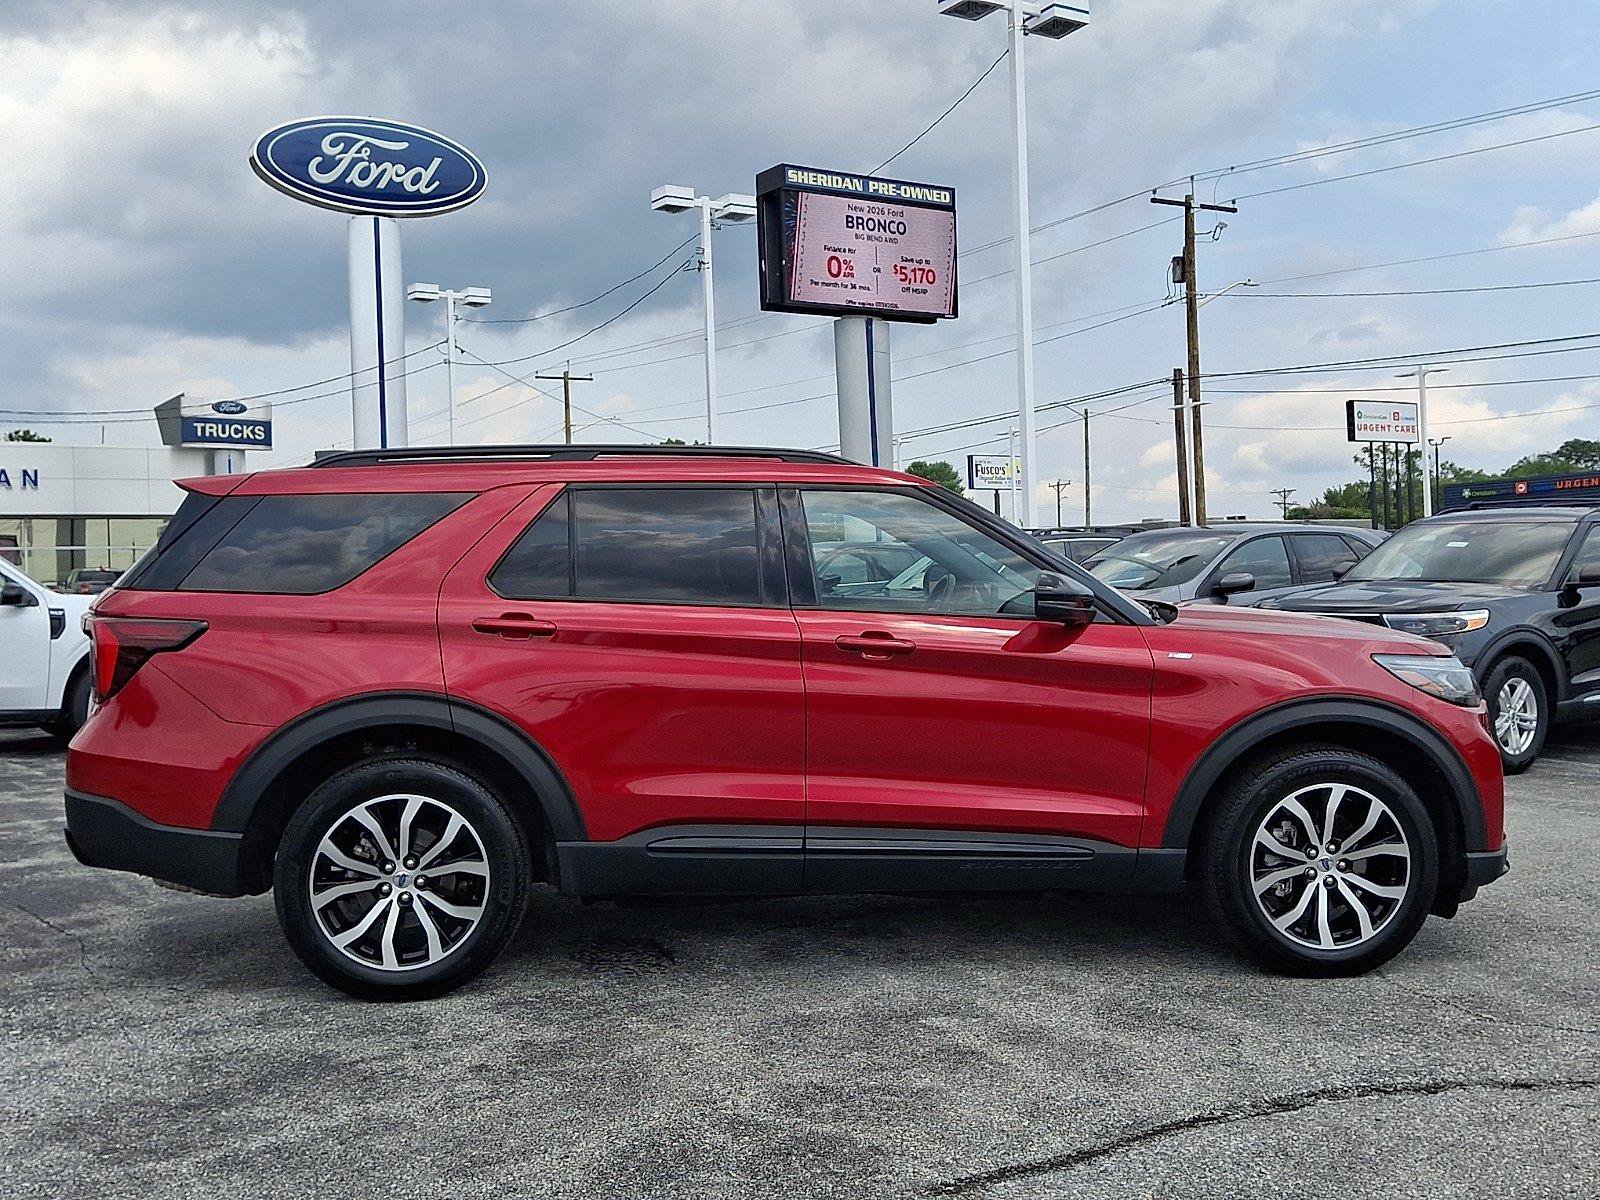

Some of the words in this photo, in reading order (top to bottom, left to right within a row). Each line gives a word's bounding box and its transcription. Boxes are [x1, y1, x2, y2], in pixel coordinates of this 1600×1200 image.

[308, 132, 443, 194] Ford
[787, 169, 863, 192] SHERIDAN
[868, 180, 950, 203] PRE-OWNED
[847, 203, 864, 213] New
[867, 205, 885, 216] 2026
[888, 208, 904, 218] Ford
[845, 214, 907, 236] BRONCO
[855, 232, 865, 241] BIG
[866, 234, 883, 243] BEND
[884, 236, 899, 245] AWD
[823, 244, 847, 254] Finance
[848, 246, 857, 255] for
[900, 255, 914, 263] Save
[925, 257, 931, 265] to
[842, 271, 855, 279] APR
[872, 266, 882, 274] OR
[893, 263, 936, 286] $5,170
[809, 278, 820, 286] Per
[821, 281, 840, 289] month
[901, 286, 911, 294] Off
[219, 402, 242, 412] Ford
[193, 422, 266, 441] TRUCKS
[1356, 423, 1391, 433] URGENT
[1394, 424, 1417, 434] CARE
